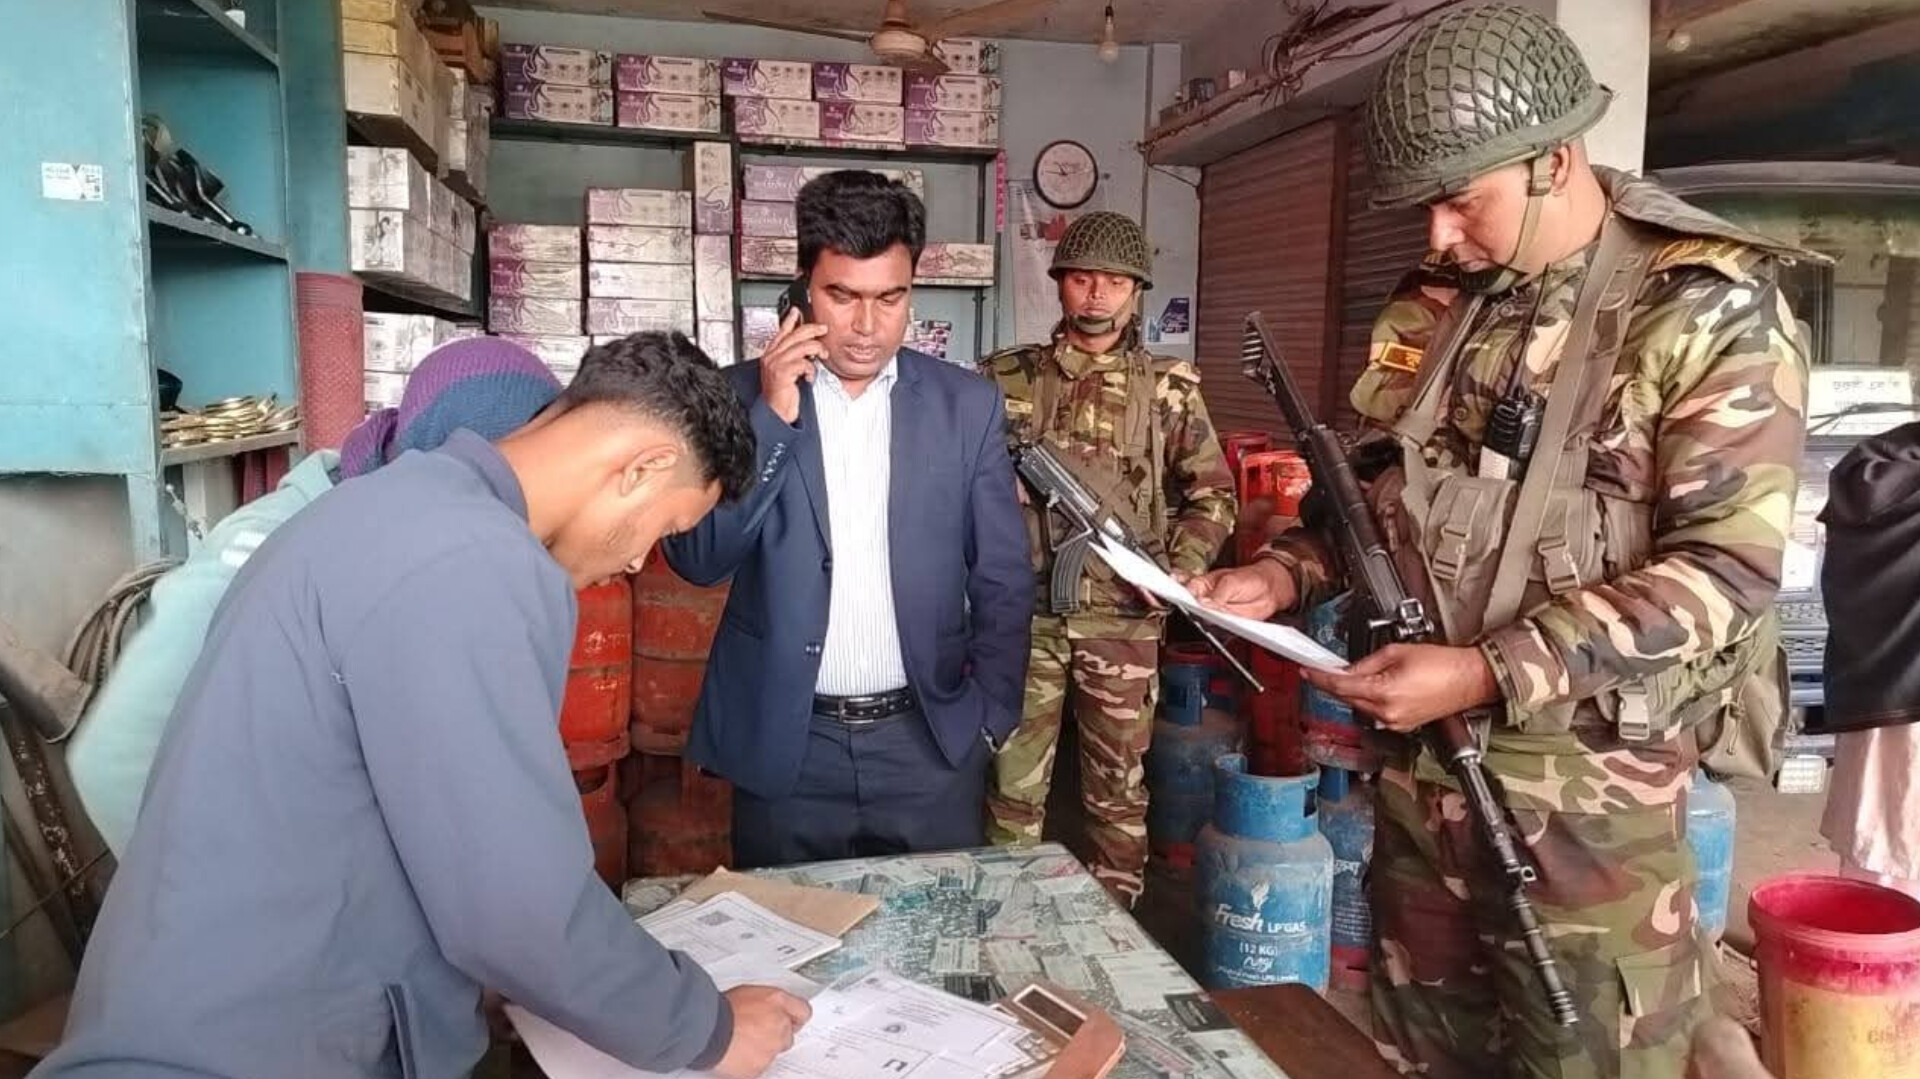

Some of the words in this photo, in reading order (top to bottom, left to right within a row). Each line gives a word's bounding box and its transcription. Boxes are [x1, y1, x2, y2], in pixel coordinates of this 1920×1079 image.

[1215, 903, 1264, 932] Fresh
[1267, 921, 1282, 933] LP
[1284, 921, 1306, 933] GAS
[1239, 941, 1257, 954] (12
[1258, 943, 1278, 956] KG)
